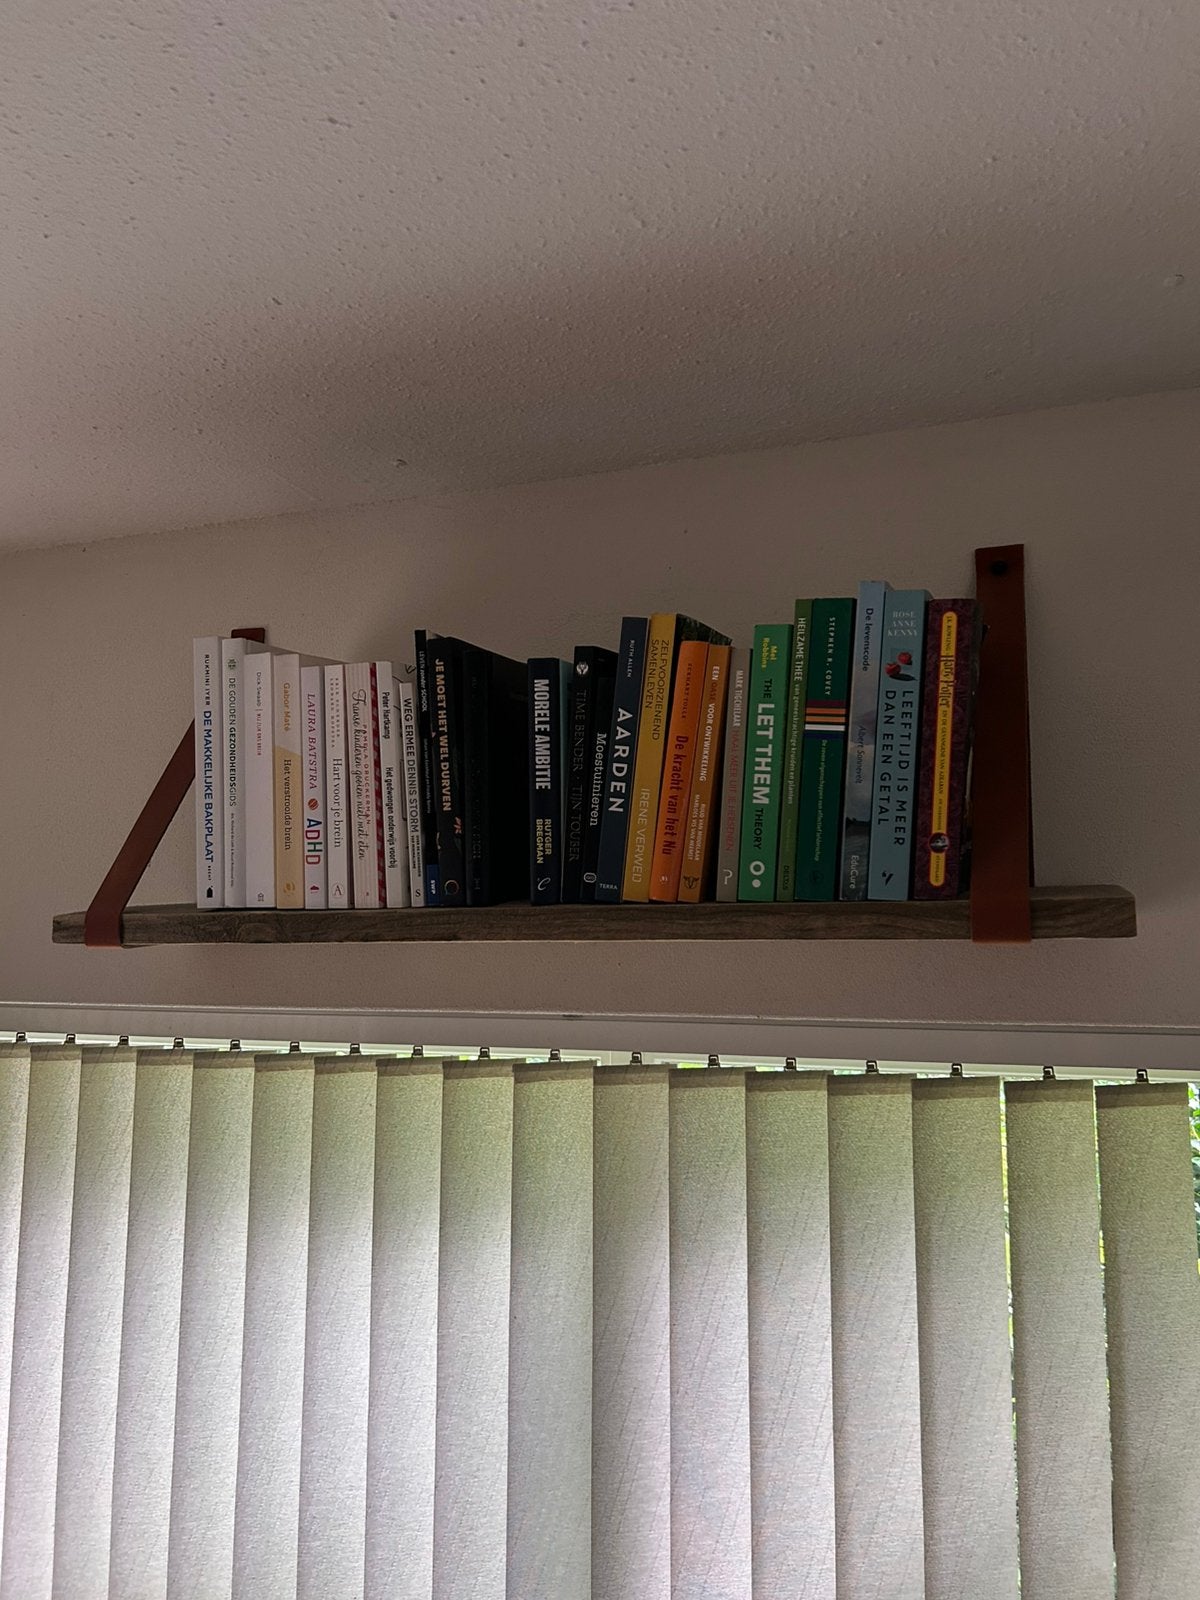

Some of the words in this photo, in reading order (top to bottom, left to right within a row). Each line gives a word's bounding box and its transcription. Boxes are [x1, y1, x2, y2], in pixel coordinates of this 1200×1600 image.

[865, 608, 874, 621] De
[795, 617, 806, 659] HEILZAME
[827, 616, 836, 654] STEPHEN
[862, 623, 873, 672] levenscode
[887, 629, 918, 637] KENNY
[435, 658, 444, 673] JE
[761, 637, 770, 669] Robbins
[939, 655, 957, 680] Harry
[229, 677, 236, 688] DE
[645, 639, 660, 709] SAMENLEVEN
[711, 665, 720, 681] EEN
[735, 670, 744, 688] MARK
[793, 661, 803, 681] THEE
[824, 669, 832, 696] COVEY
[283, 682, 291, 709] Gabor
[382, 691, 391, 708] Peter
[436, 674, 446, 708] MOET
[652, 639, 670, 741] ZELFVOORZIENEND
[763, 678, 773, 699] THE
[938, 680, 957, 708] Potter
[203, 710, 212, 727] DE
[307, 693, 316, 733] LAURA
[351, 689, 367, 727] Franse
[403, 698, 413, 722] WEG
[533, 679, 550, 732] MORELE
[575, 690, 587, 720] TIME
[705, 703, 716, 724] VOOR
[733, 689, 743, 727] TIGCHELAAR
[884, 690, 896, 725] DAN
[382, 709, 392, 739] Hartkamp
[437, 710, 448, 732] HET
[756, 703, 775, 740] LET
[790, 695, 800, 747] geneeskrachtige
[858, 725, 867, 748] Albert
[898, 690, 914, 770] LEEFTIJD
[354, 728, 365, 769] kinderen
[405, 725, 415, 757] ERMEE
[439, 735, 449, 760] WEL
[573, 724, 585, 772] BENDER
[675, 735, 689, 750] De
[699, 725, 713, 782] ONTWIKKELING
[881, 733, 894, 764] EEN
[203, 728, 212, 800] MAKKELIJKE
[229, 727, 237, 807] GEZONDHEIDSGIDS
[283, 759, 291, 774] Het
[308, 736, 317, 790] BATSTRA
[333, 758, 343, 781] Hart
[386, 767, 394, 777] Het
[535, 734, 551, 790] AMBITIE
[608, 707, 633, 813] AARDEN
[670, 753, 687, 791] kracht
[752, 743, 773, 805] THEM
[789, 747, 798, 771] kruiden
[351, 770, 364, 797] gooien
[407, 759, 418, 795] DENNIS
[440, 762, 452, 812] DURVEN
[590, 732, 607, 827] Moestuinieren
[786, 780, 795, 805] planten
[897, 778, 909, 792] IS
[284, 776, 292, 826] verstrooide
[333, 783, 342, 806] voor
[356, 801, 369, 818] niet
[385, 778, 396, 814] gedwongen
[572, 784, 583, 810] TIJN
[637, 787, 651, 826] IRENE
[667, 794, 679, 814] van
[878, 771, 892, 825] GETAL
[330, 807, 342, 818] je
[409, 799, 420, 833] STORM
[664, 817, 679, 837] het
[894, 800, 907, 846] MEER
[204, 802, 213, 863] BAKPLAAT
[284, 827, 292, 850] brein
[305, 818, 323, 865] ADHD
[333, 820, 344, 848] brein
[357, 821, 369, 837] met
[387, 815, 397, 846] onderwijs
[536, 818, 544, 864] BREGMAN
[544, 818, 552, 856] RUTGER
[569, 815, 582, 862] TOUBER
[753, 808, 764, 850] THEORY
[358, 840, 369, 859] eten
[388, 847, 399, 869] voorbij
[662, 840, 676, 855] Nu
[849, 854, 860, 889] EduCure
